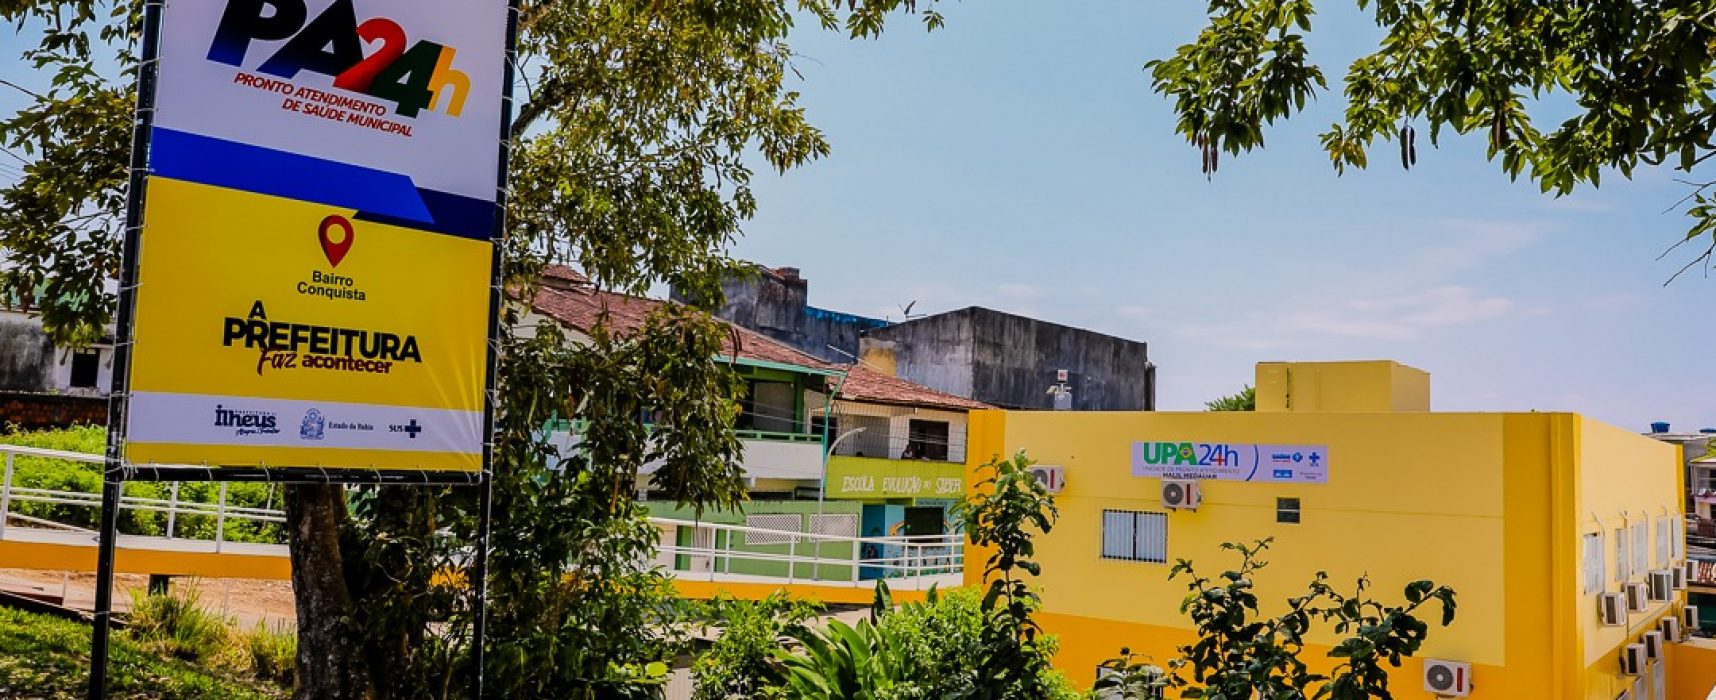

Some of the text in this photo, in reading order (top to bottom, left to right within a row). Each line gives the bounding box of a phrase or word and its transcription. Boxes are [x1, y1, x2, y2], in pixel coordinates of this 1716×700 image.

[234, 72, 387, 117] PRONTO ATENDIMENTO
[282, 99, 302, 112] DE
[346, 114, 413, 137] MUNICIPAL
[312, 270, 354, 287] Bairro
[296, 281, 366, 301] Conquista
[248, 300, 267, 320] A
[223, 316, 422, 363] PREFEITURA
[257, 347, 393, 376] Faz acontecer
[388, 424, 404, 433] SUS
[841, 475, 875, 493] ESCOLA
